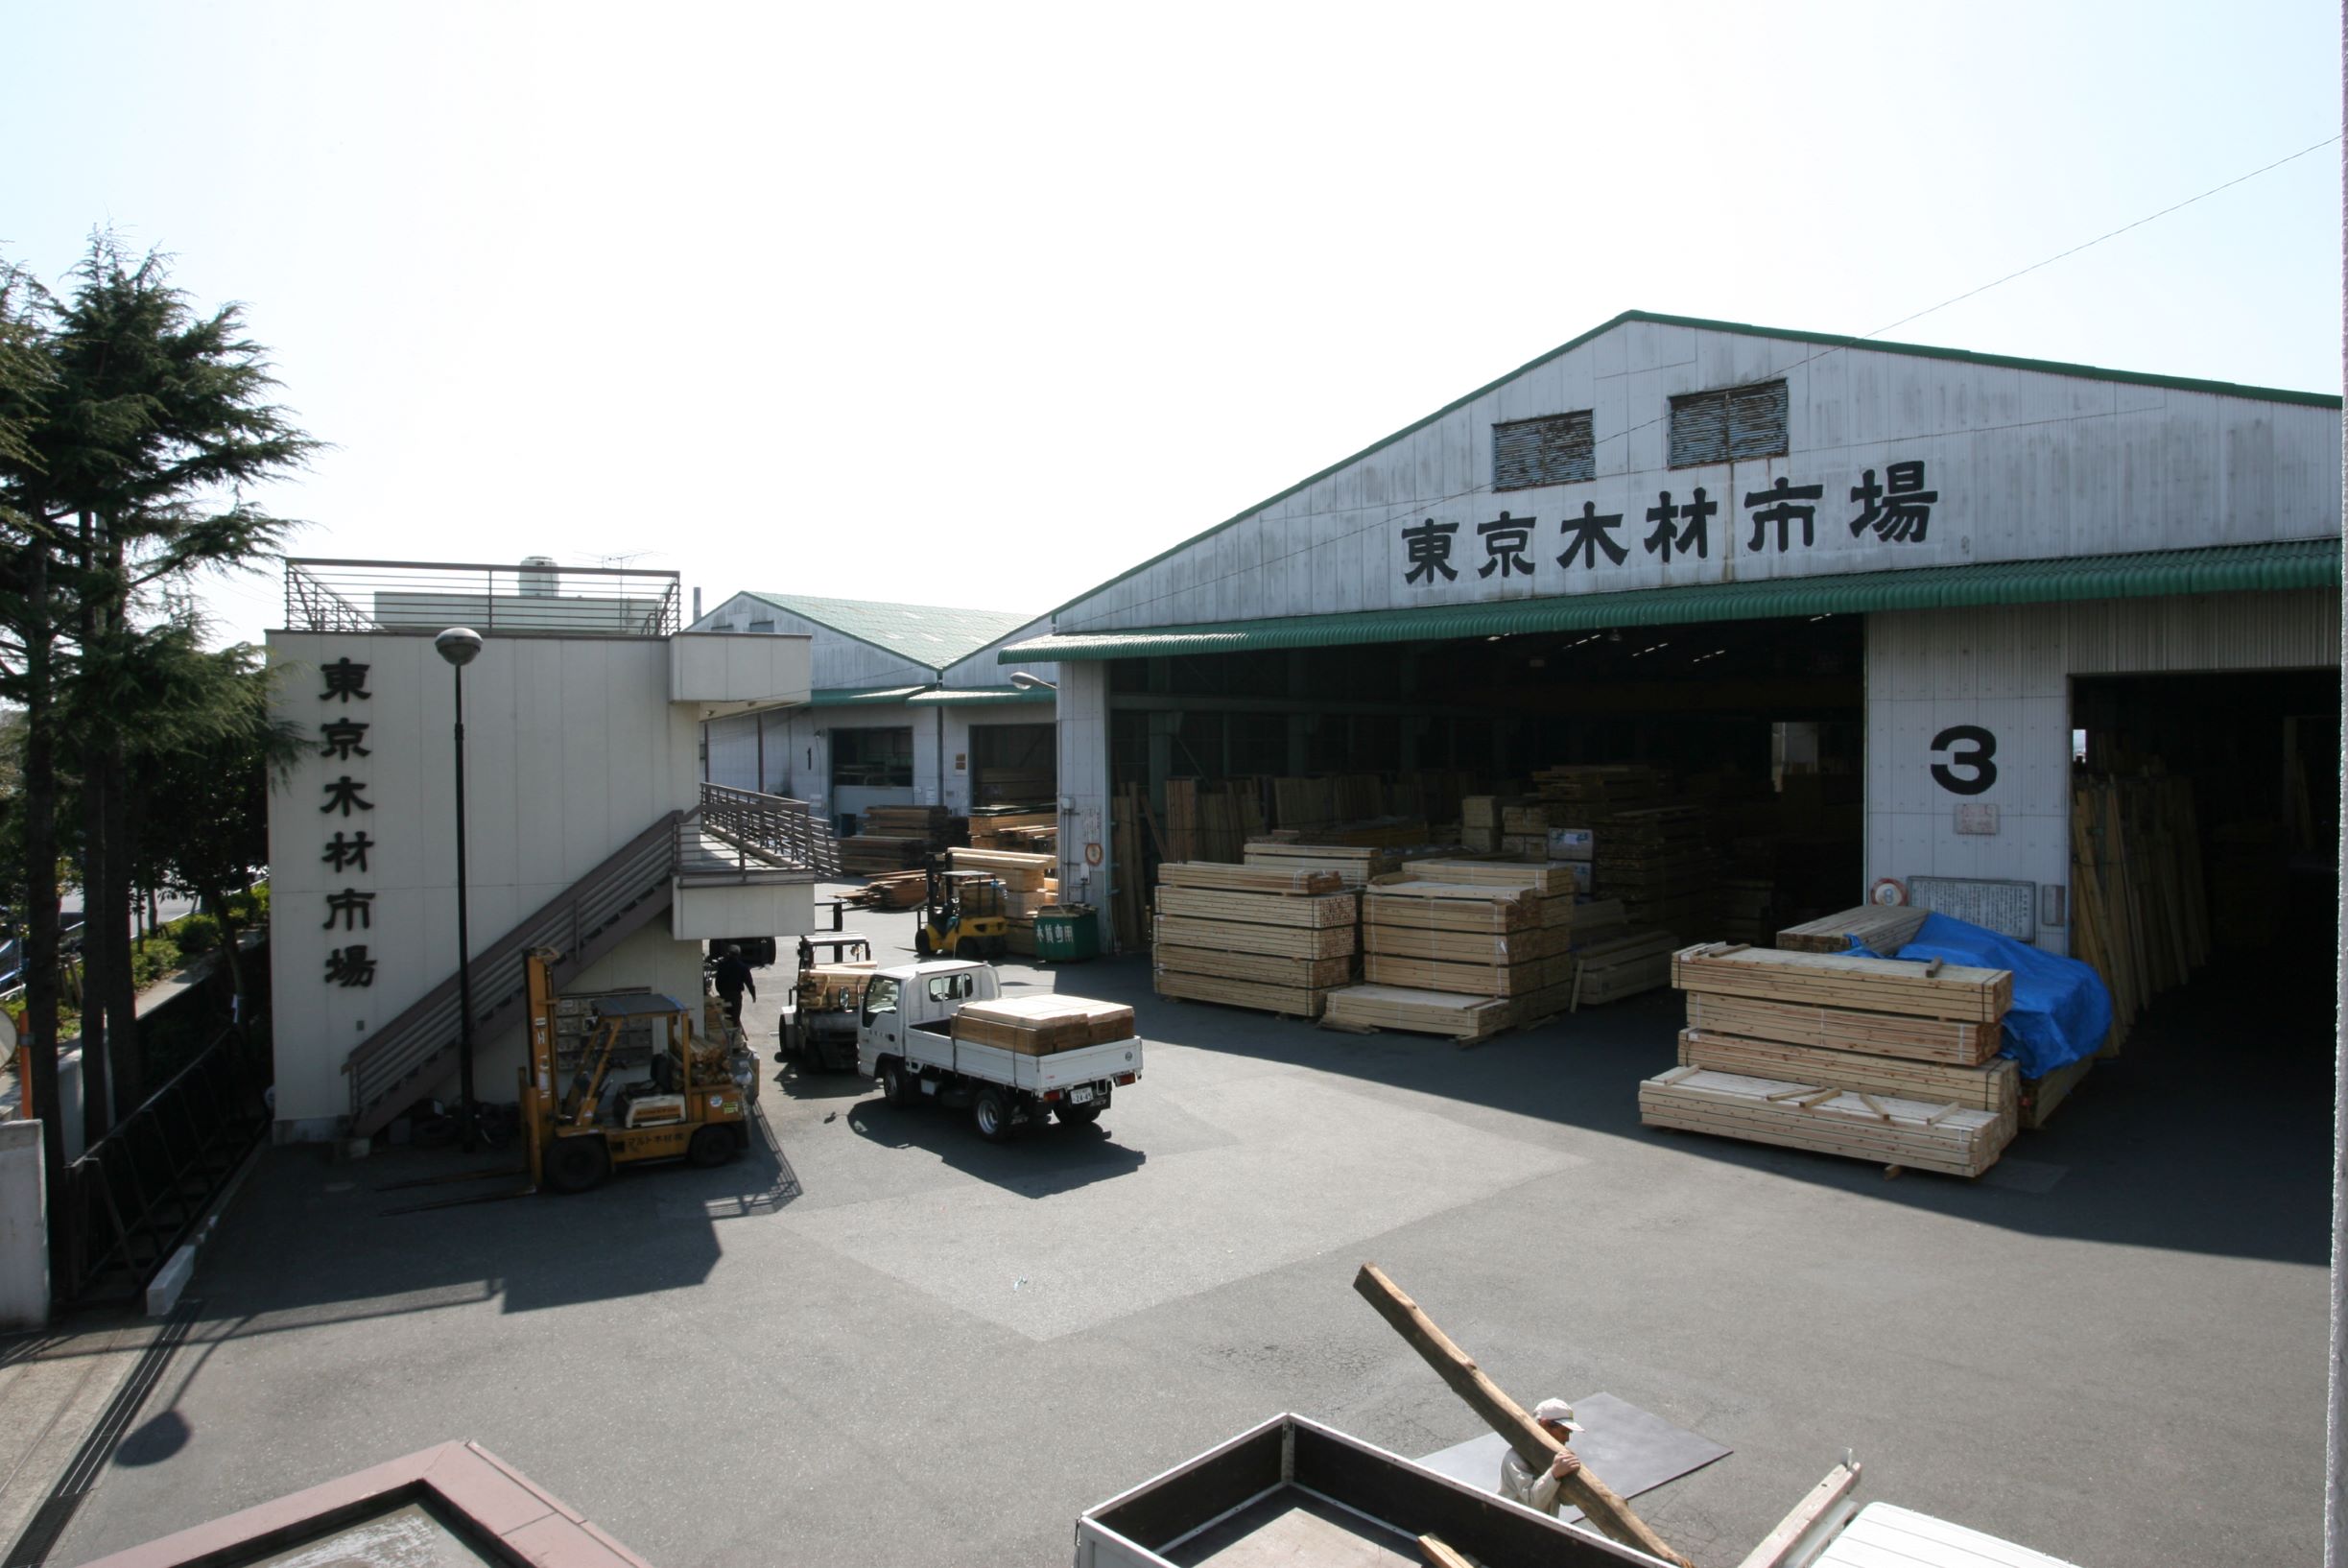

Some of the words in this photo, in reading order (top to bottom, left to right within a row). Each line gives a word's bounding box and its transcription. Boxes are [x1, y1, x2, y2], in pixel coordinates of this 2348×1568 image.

[1401, 460, 1938, 584] 東京木材市場
[318, 656, 378, 989] 東京木材市場
[1930, 725, 1998, 796] 3
